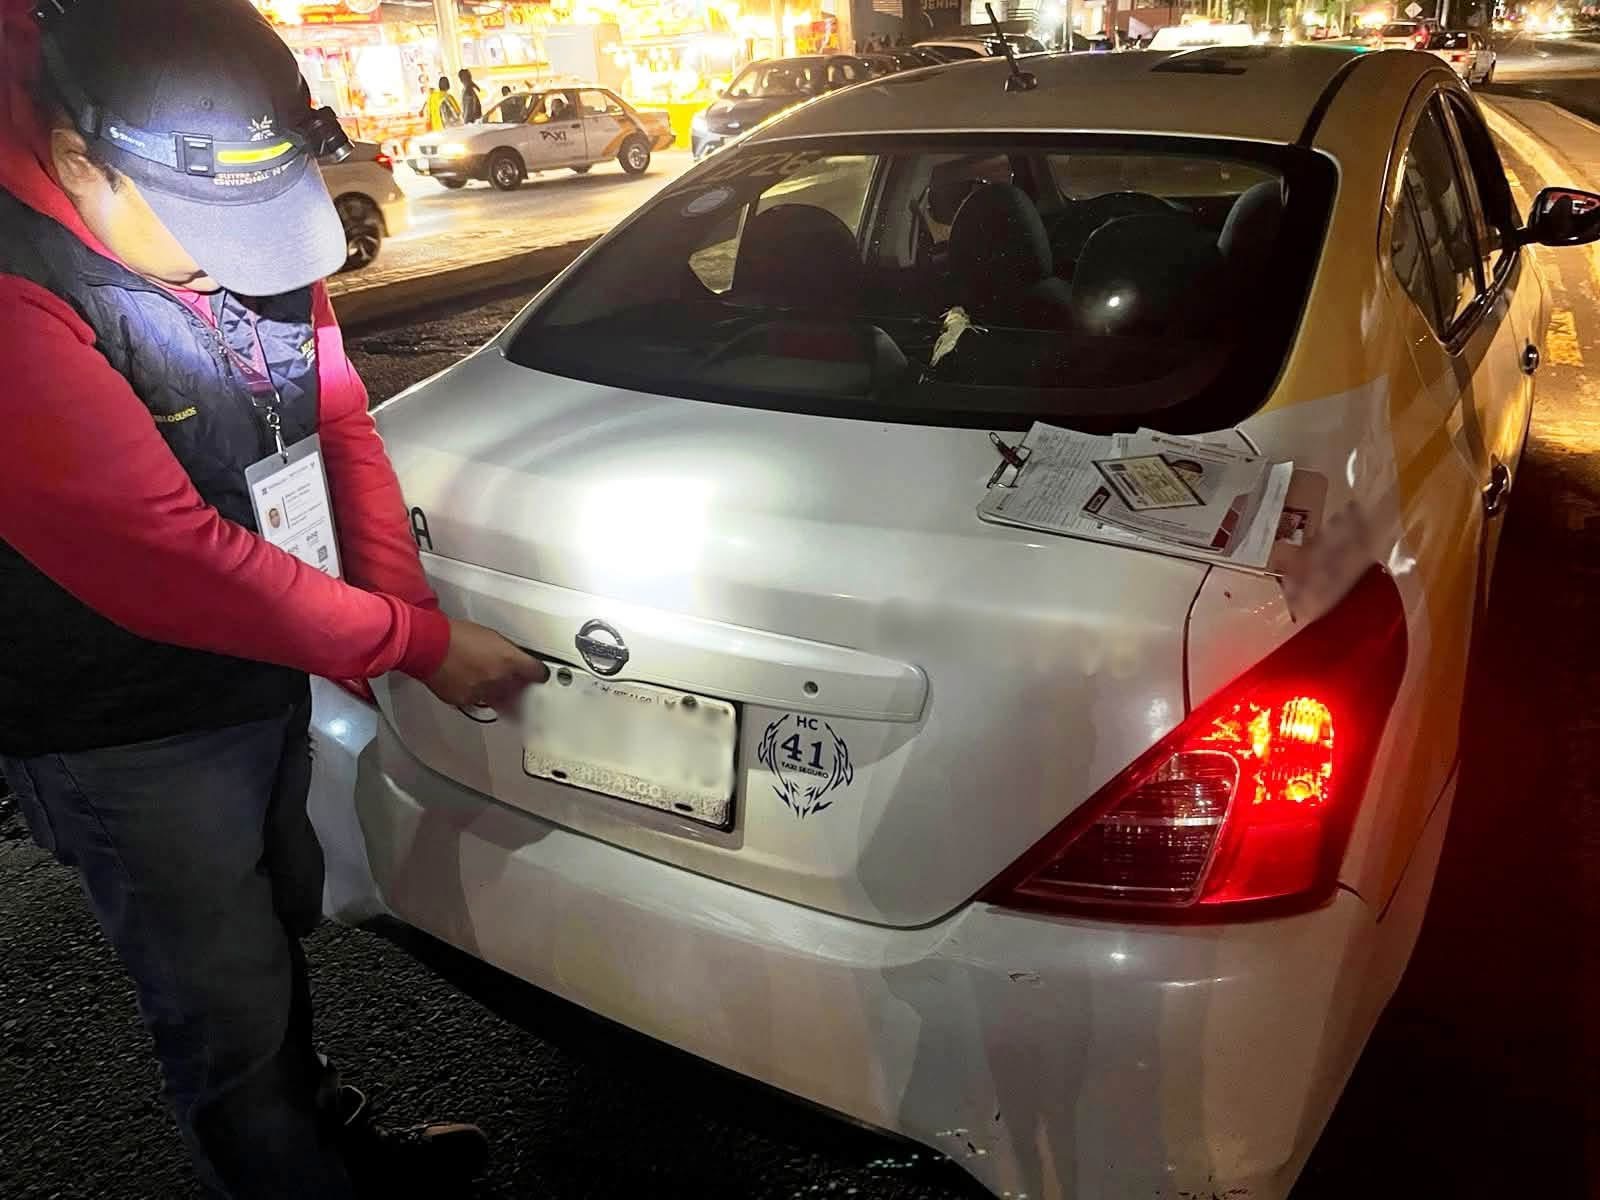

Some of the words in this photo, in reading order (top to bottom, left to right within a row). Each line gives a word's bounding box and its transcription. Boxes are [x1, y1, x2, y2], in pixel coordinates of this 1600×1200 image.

[796, 715, 819, 731] HC
[781, 733, 824, 770] 41
[781, 761, 798, 770] TAXI
[799, 766, 829, 779] SEGURO
